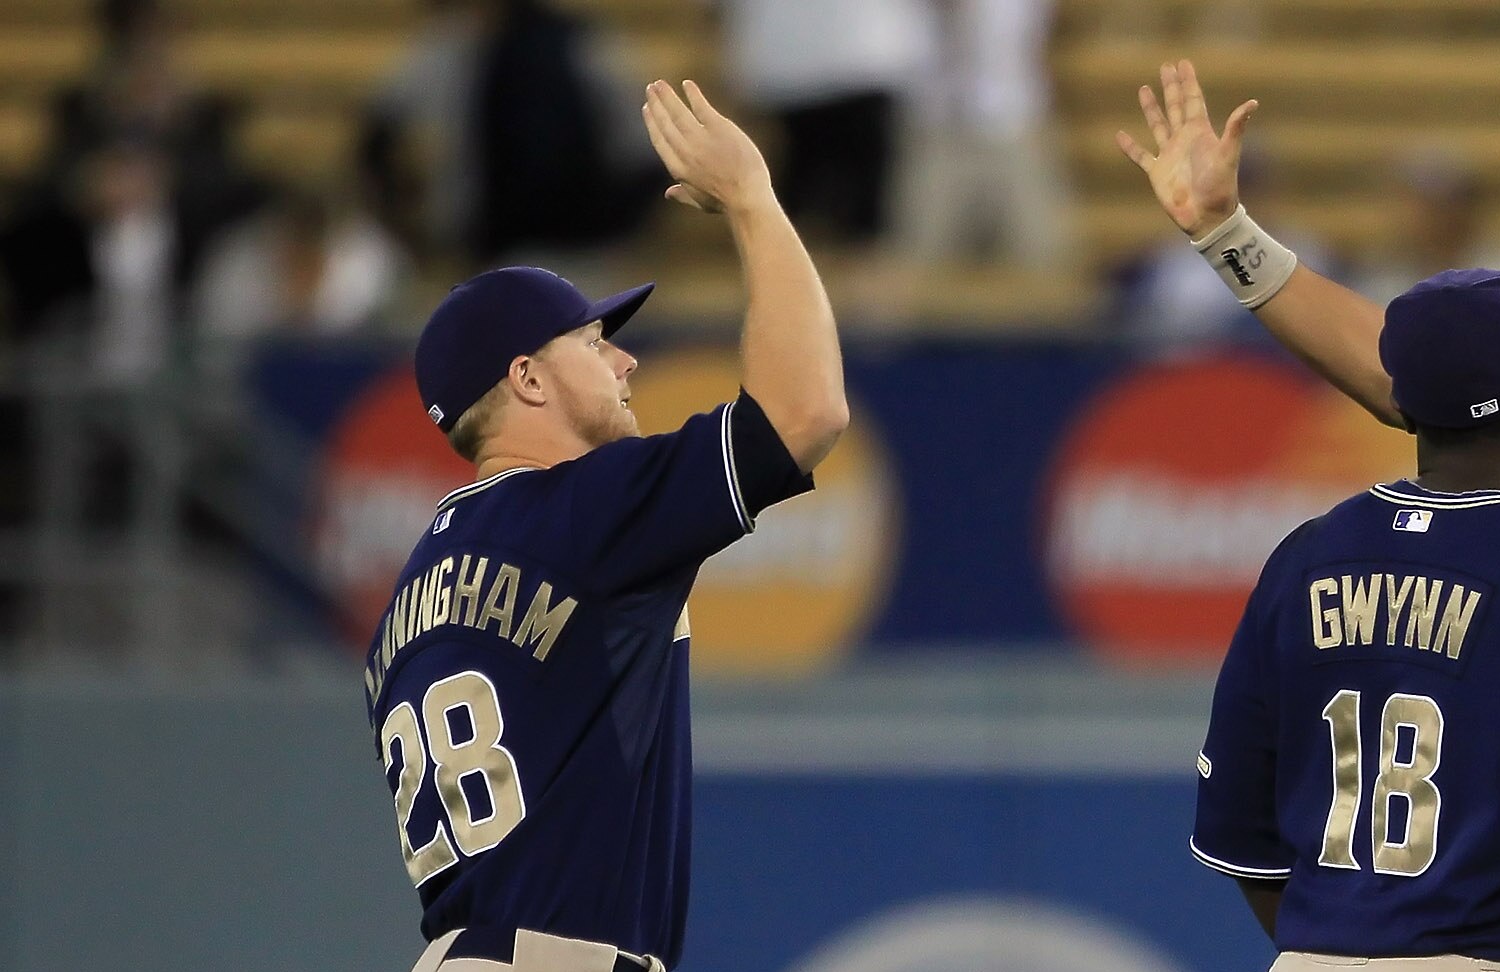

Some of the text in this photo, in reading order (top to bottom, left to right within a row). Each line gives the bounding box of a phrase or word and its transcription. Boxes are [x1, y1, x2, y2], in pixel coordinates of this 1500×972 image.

[1240, 235, 1268, 270] 25
[364, 554, 579, 708] UNNINGHAM
[1309, 573, 1482, 660] GWYNN
[381, 669, 526, 878] 28
[1318, 689, 1444, 877] 18
